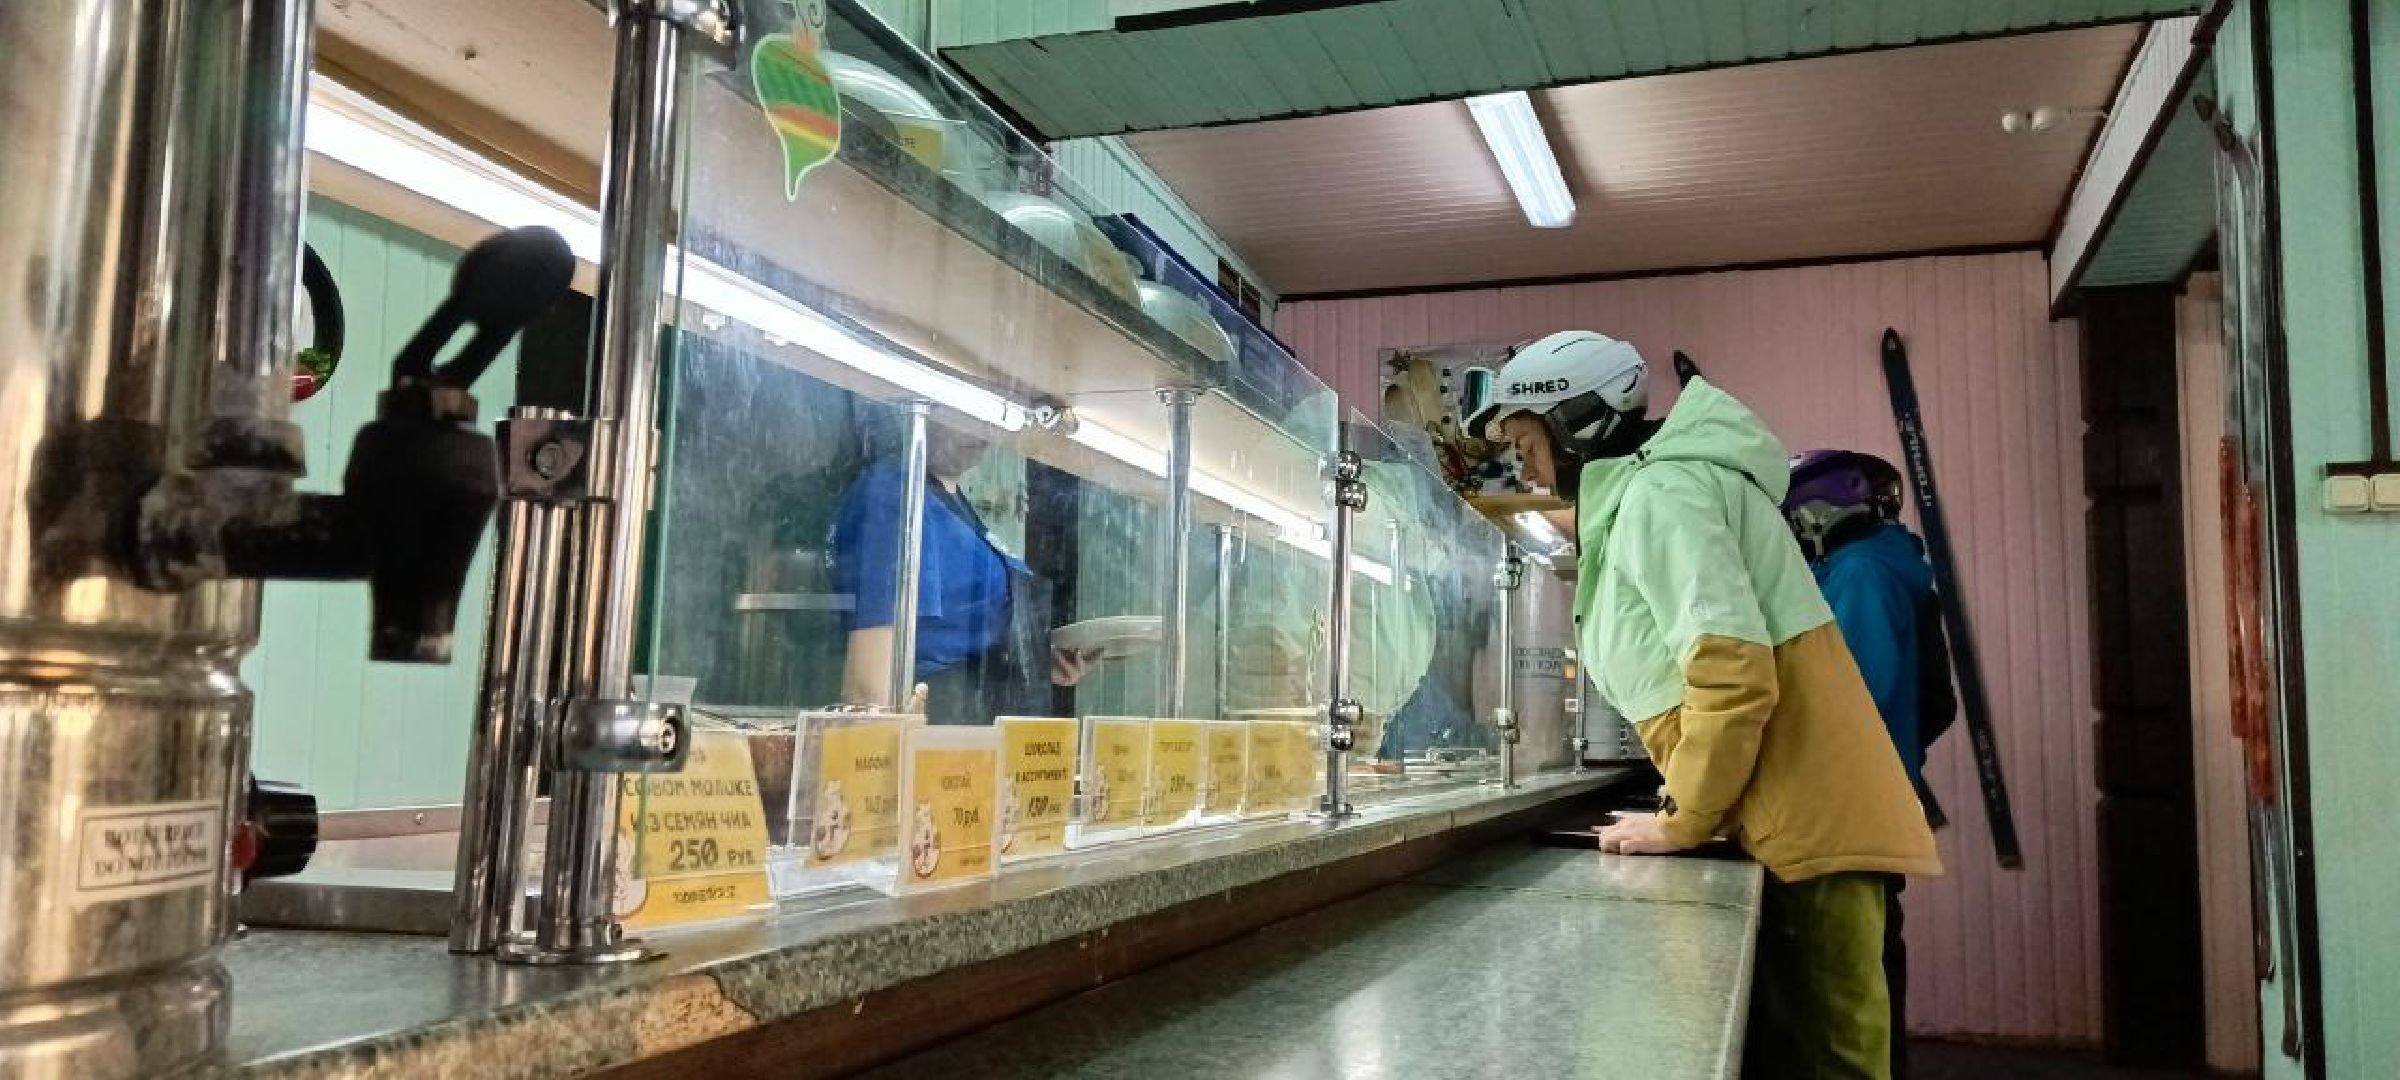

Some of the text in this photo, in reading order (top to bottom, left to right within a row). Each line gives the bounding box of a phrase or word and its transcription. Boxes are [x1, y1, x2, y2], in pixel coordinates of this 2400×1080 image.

[1511, 378, 1570, 396] SHRED
[690, 778, 754, 797] МОЛОКЕ
[664, 811, 717, 832] СЕМЯН
[720, 810, 751, 830] ЧИА
[669, 837, 720, 871] 250
